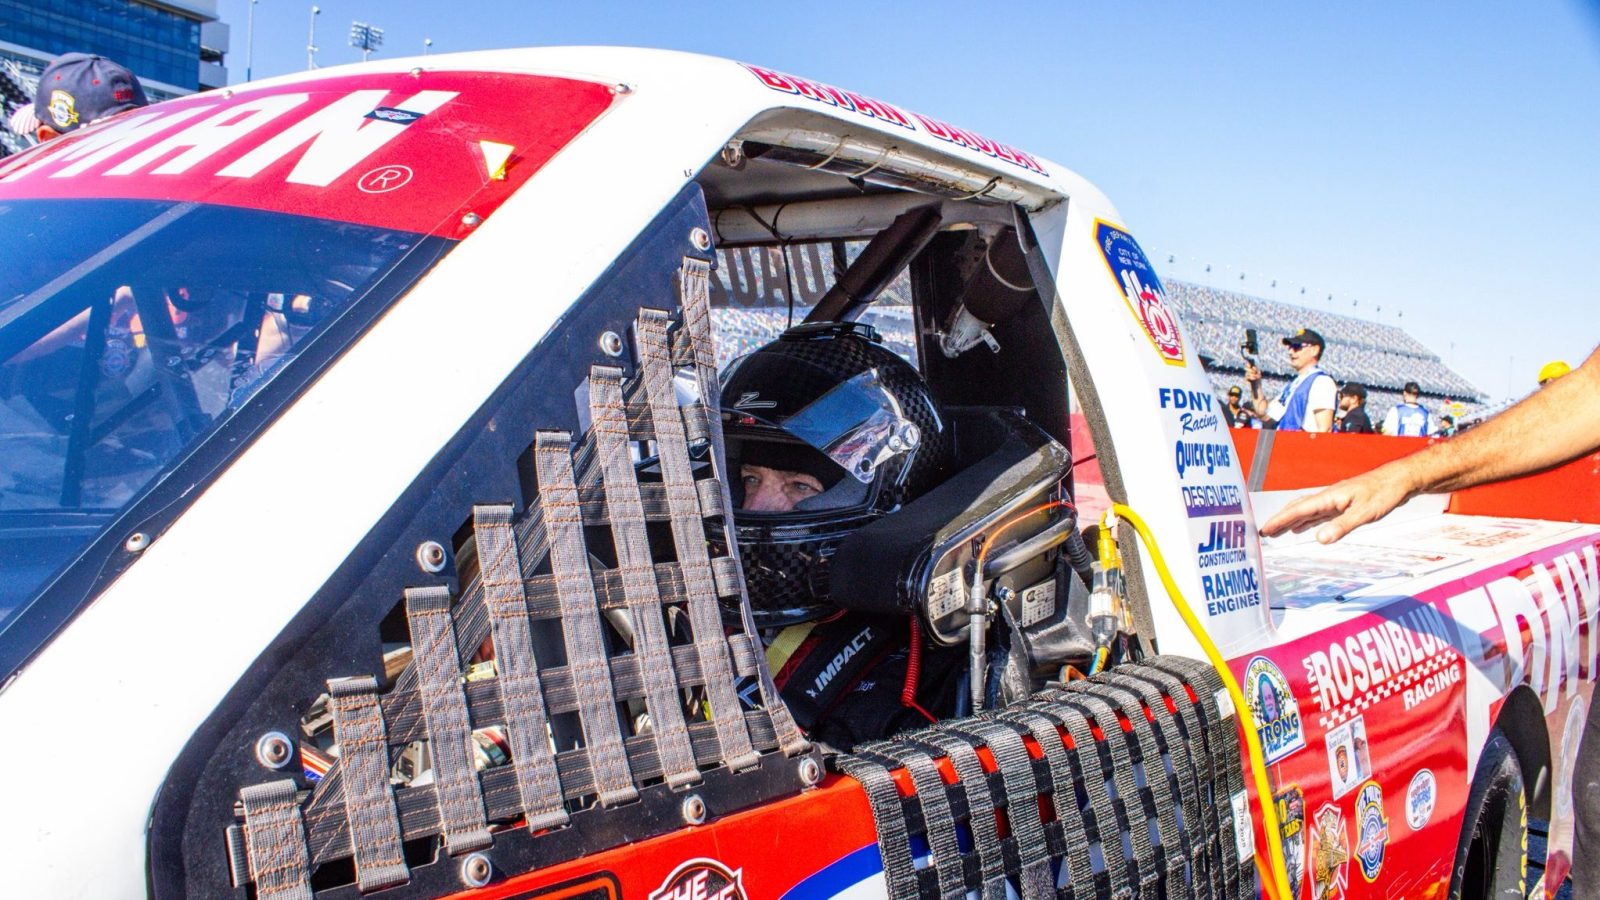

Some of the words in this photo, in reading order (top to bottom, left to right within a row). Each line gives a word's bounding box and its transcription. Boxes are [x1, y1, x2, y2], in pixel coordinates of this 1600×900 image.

[737, 62, 917, 131] BRYAN
[0, 89, 459, 188] MAN
[1118, 247, 1131, 258] CITY
[1131, 252, 1139, 260] OF
[1118, 256, 1132, 266] NEW
[1132, 260, 1148, 271] YORK
[1159, 388, 1212, 412] FDNY
[1179, 412, 1219, 435] Racing
[1175, 440, 1206, 479] QUICK
[1206, 442, 1231, 475] SIGNS
[1197, 520, 1247, 554] JHR
[1198, 549, 1247, 569] CONSTRUCTION
[1202, 567, 1259, 602] RAHMOC
[1208, 593, 1261, 616] ENGINES
[815, 626, 875, 692] IMPACT
[1310, 601, 1454, 712] ROSENBLUM
[1403, 664, 1461, 711] RACING
[1257, 712, 1300, 746] TRONG
